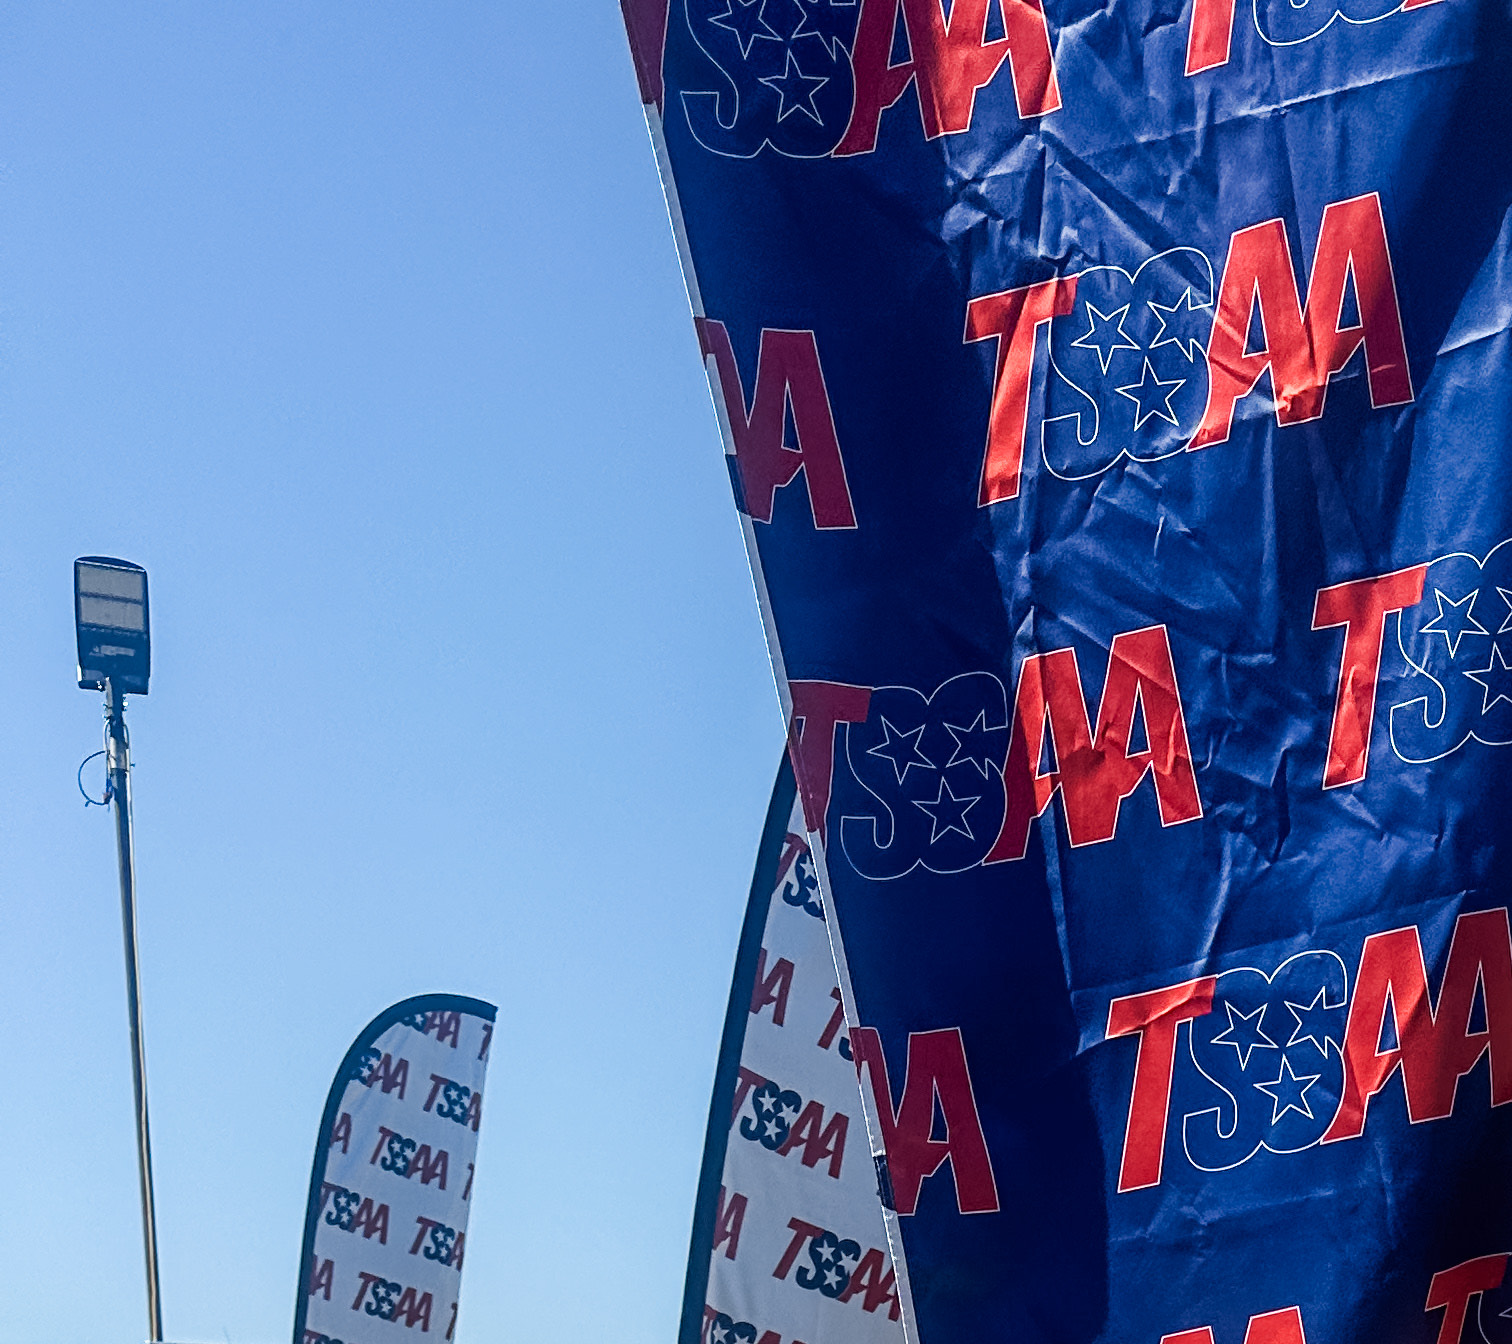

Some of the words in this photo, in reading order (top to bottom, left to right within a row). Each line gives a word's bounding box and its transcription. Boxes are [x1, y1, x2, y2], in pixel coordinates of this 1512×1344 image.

[963, 191, 1415, 508] TSSAA
[370, 1125, 449, 1191] TSSAA
[352, 1271, 433, 1334] TSSAA
